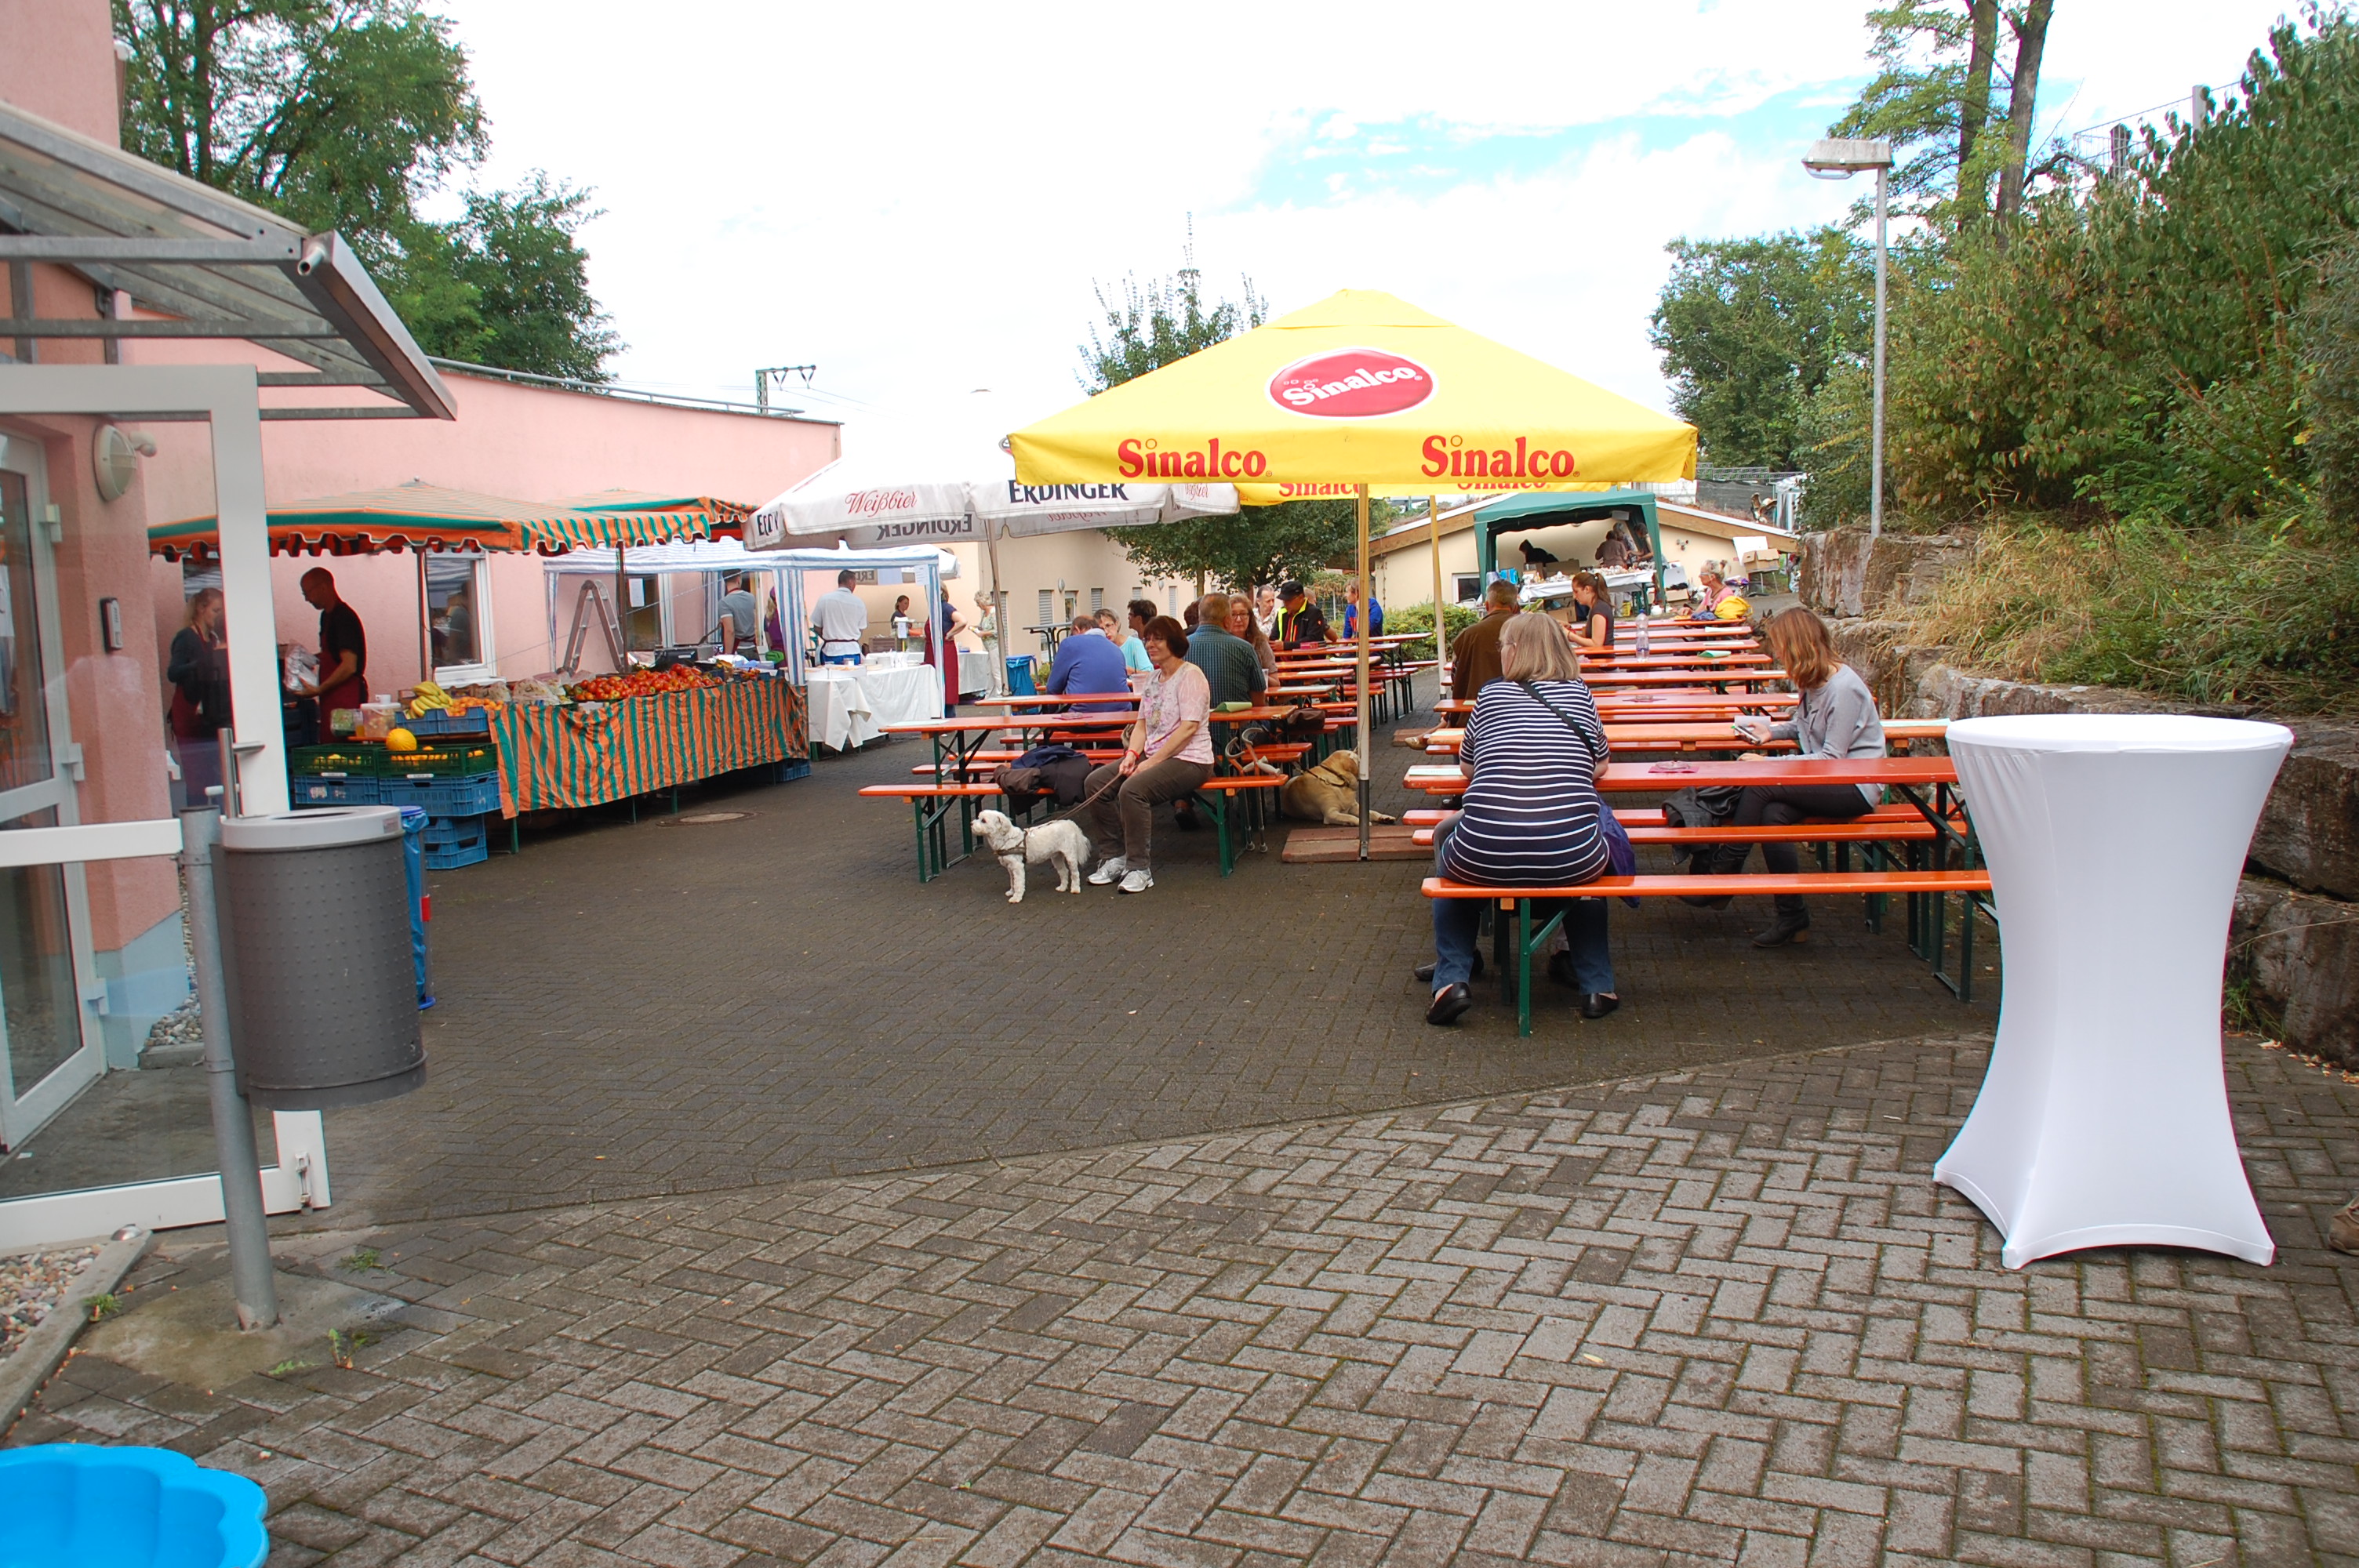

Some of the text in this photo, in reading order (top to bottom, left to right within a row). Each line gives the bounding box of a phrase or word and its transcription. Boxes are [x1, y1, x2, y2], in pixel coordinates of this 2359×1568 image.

[1282, 367, 1417, 405] Sinalco
[1118, 437, 1267, 478] Sinalco
[1421, 434, 1575, 477] Sinalco
[845, 490, 918, 517] Weißbier
[1008, 479, 1129, 504] ERDINGER
